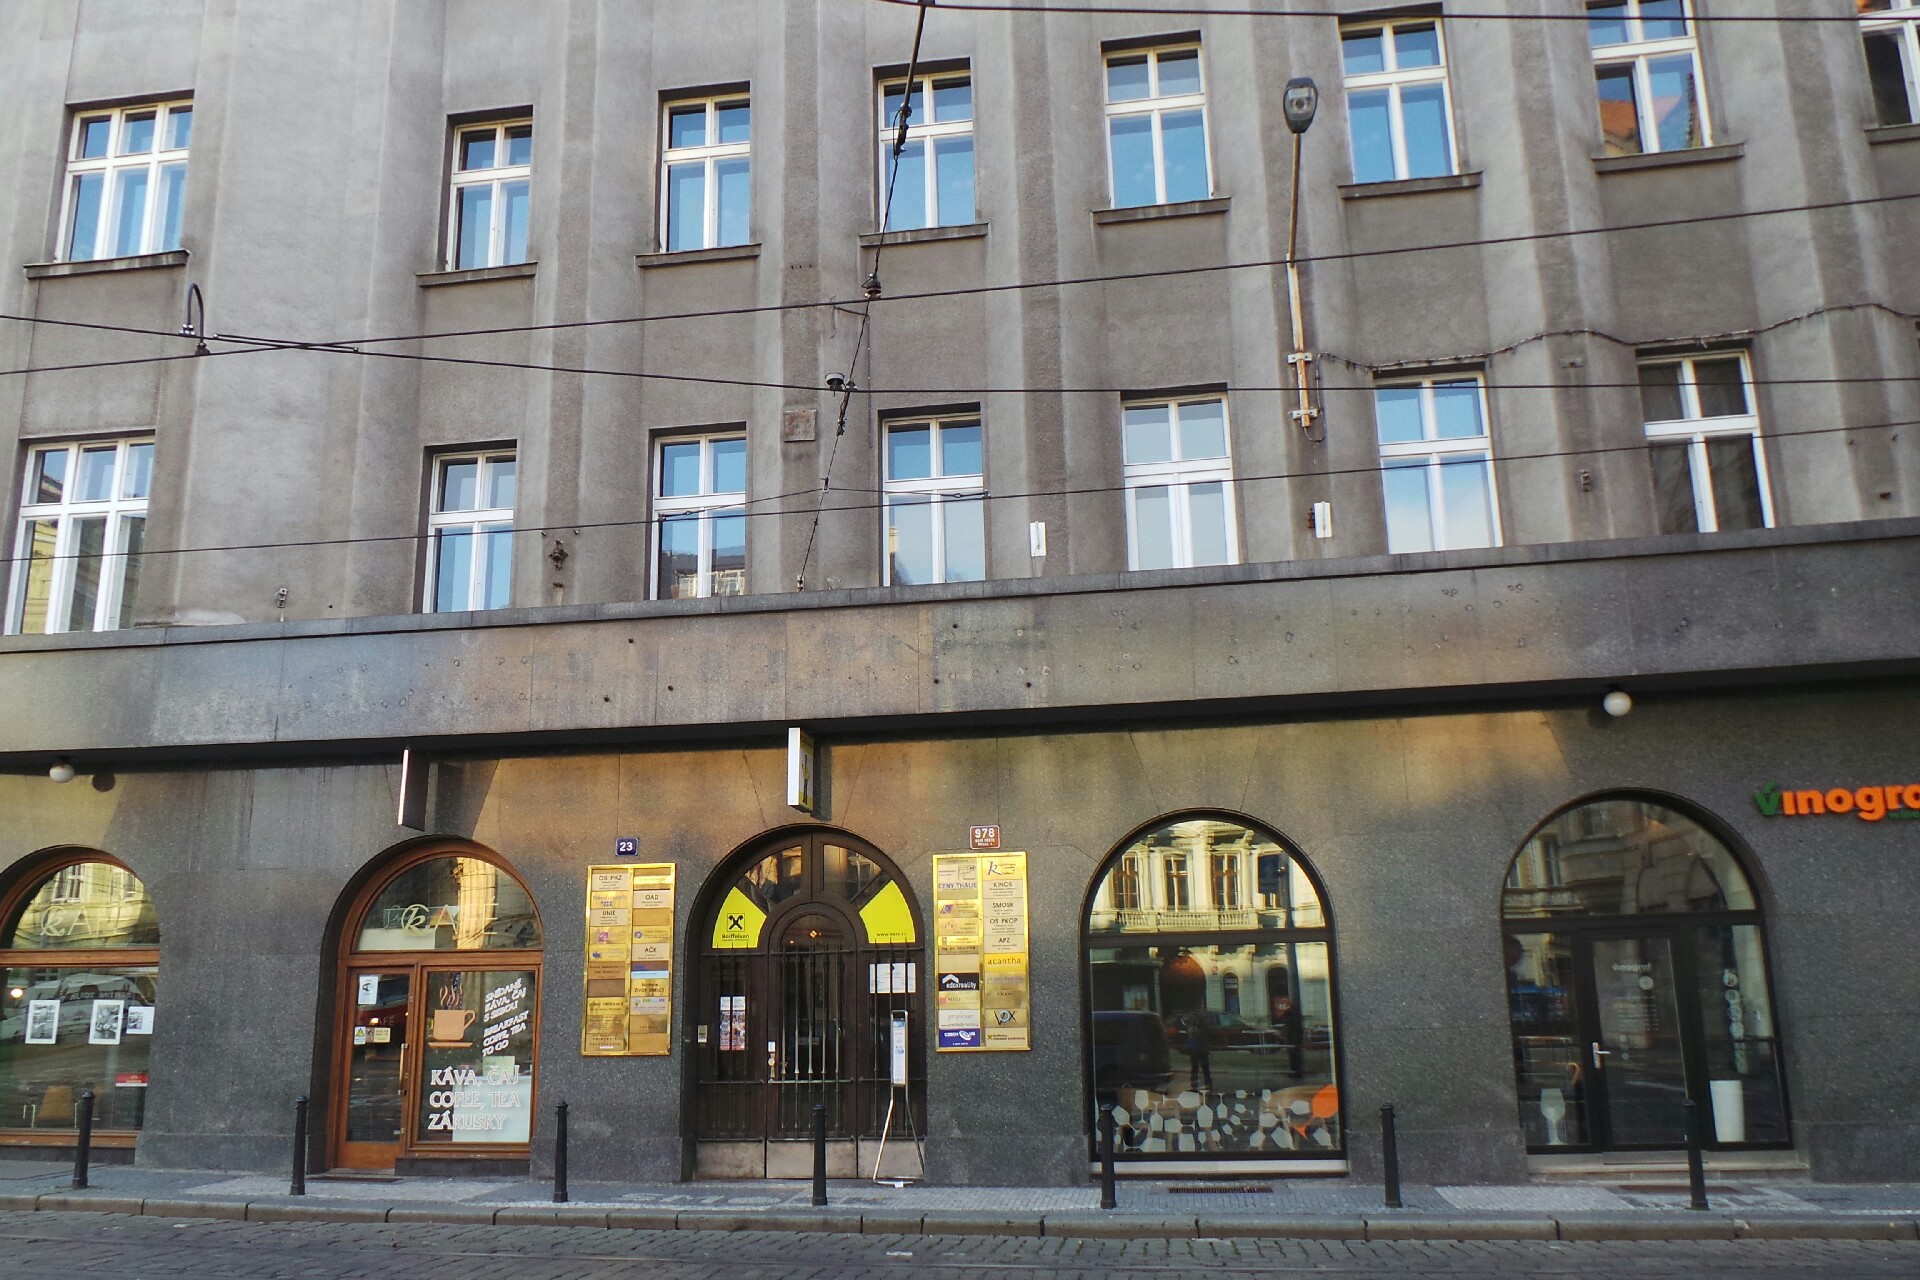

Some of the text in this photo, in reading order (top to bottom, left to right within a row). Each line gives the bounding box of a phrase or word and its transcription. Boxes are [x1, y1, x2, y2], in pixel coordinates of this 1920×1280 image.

[975, 828, 995, 838] 978
[619, 842, 633, 852] 23
[987, 956, 1021, 965] acantha
[482, 1040, 510, 1057] TO GO
[430, 1064, 520, 1087] KÁVA, ČAJ
[489, 1091, 522, 1108] TEA
[428, 1110, 506, 1130] ZÁKUSKY
